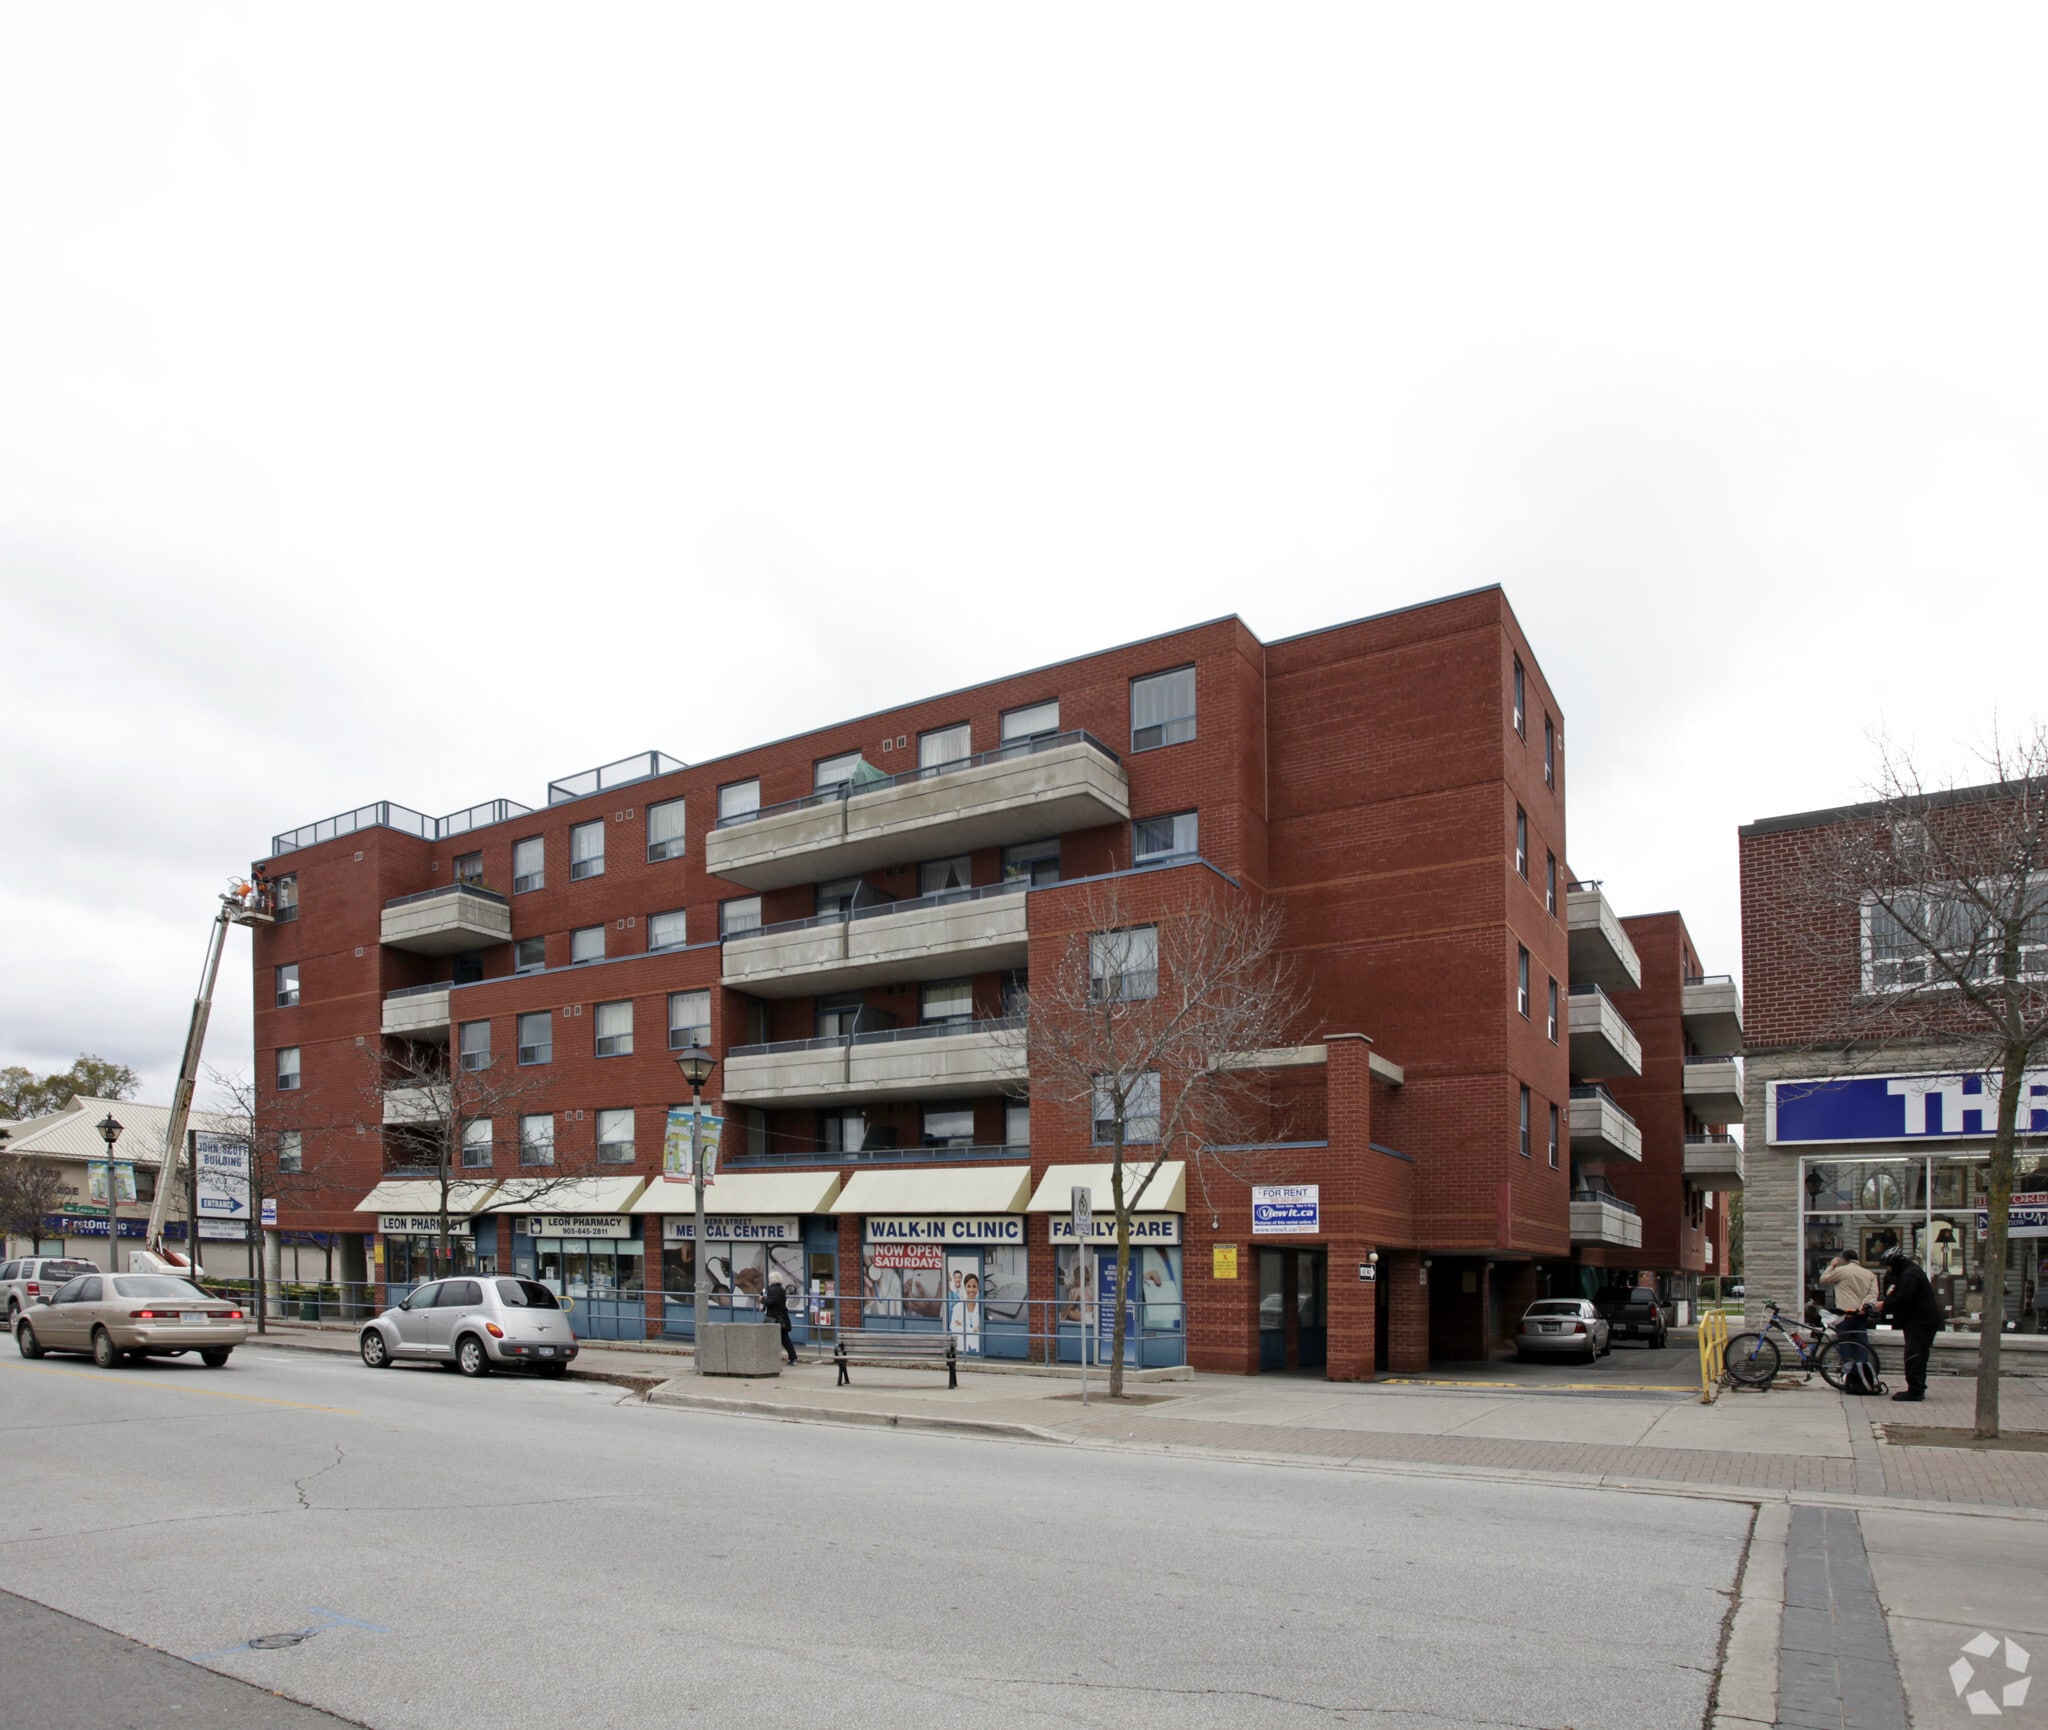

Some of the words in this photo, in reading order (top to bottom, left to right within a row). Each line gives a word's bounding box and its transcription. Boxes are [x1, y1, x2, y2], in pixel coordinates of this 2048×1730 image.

[198, 1143, 218, 1153] JOHN
[222, 1145, 248, 1156] SCOTT
[204, 1155, 241, 1167] BUILDING
[383, 1217, 407, 1229] LEON
[548, 1218, 570, 1226] LEON
[573, 1218, 622, 1226] PHARMACY
[676, 1225, 730, 1237] MECAL
[733, 1225, 784, 1238] CENTRE
[871, 1221, 946, 1237] WALK-IN
[952, 1221, 1019, 1238] CLINIC
[1053, 1222, 1116, 1236] FAILY
[875, 1244, 904, 1256] NOW
[907, 1244, 942, 1257] OPEN
[874, 1256, 942, 1268] SATURDAYS
